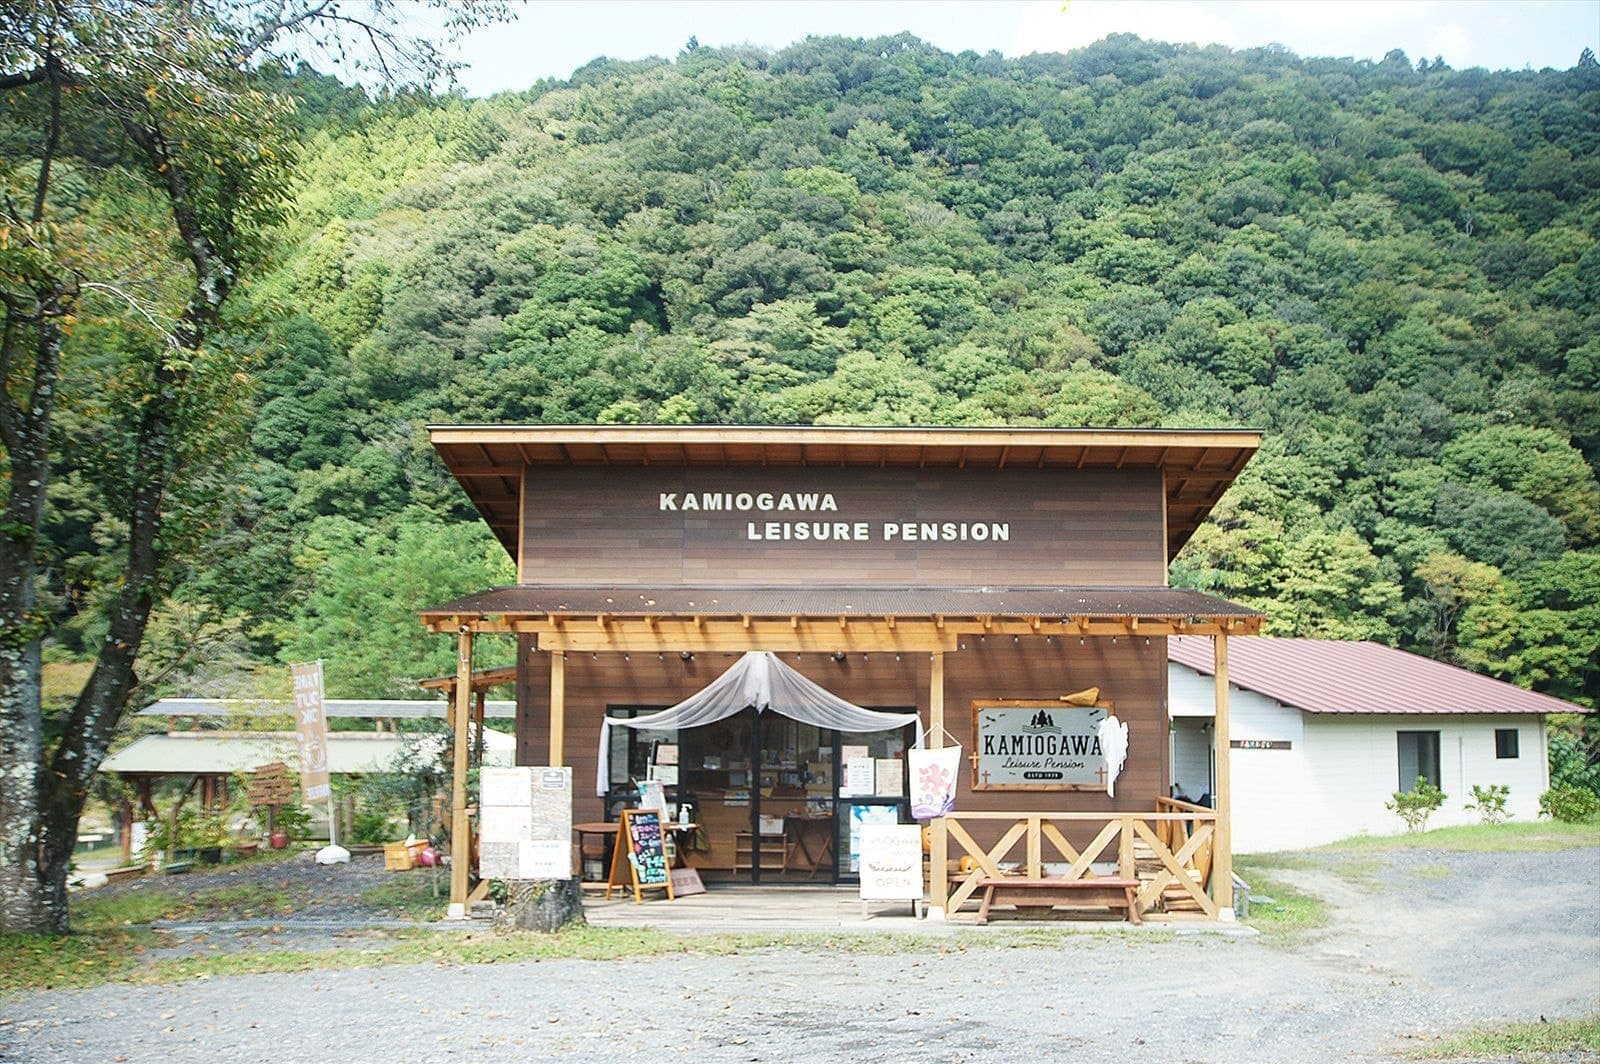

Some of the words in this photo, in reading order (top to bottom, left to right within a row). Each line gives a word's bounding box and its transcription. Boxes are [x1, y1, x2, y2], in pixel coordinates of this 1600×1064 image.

[659, 493, 838, 511] KAMIOGAWA
[747, 522, 870, 541] LEISURE
[883, 522, 1010, 541] PENSION
[984, 735, 1102, 756] KAMIOGAWA
[1002, 757, 1041, 768] Leisure
[1044, 757, 1084, 768] Pension
